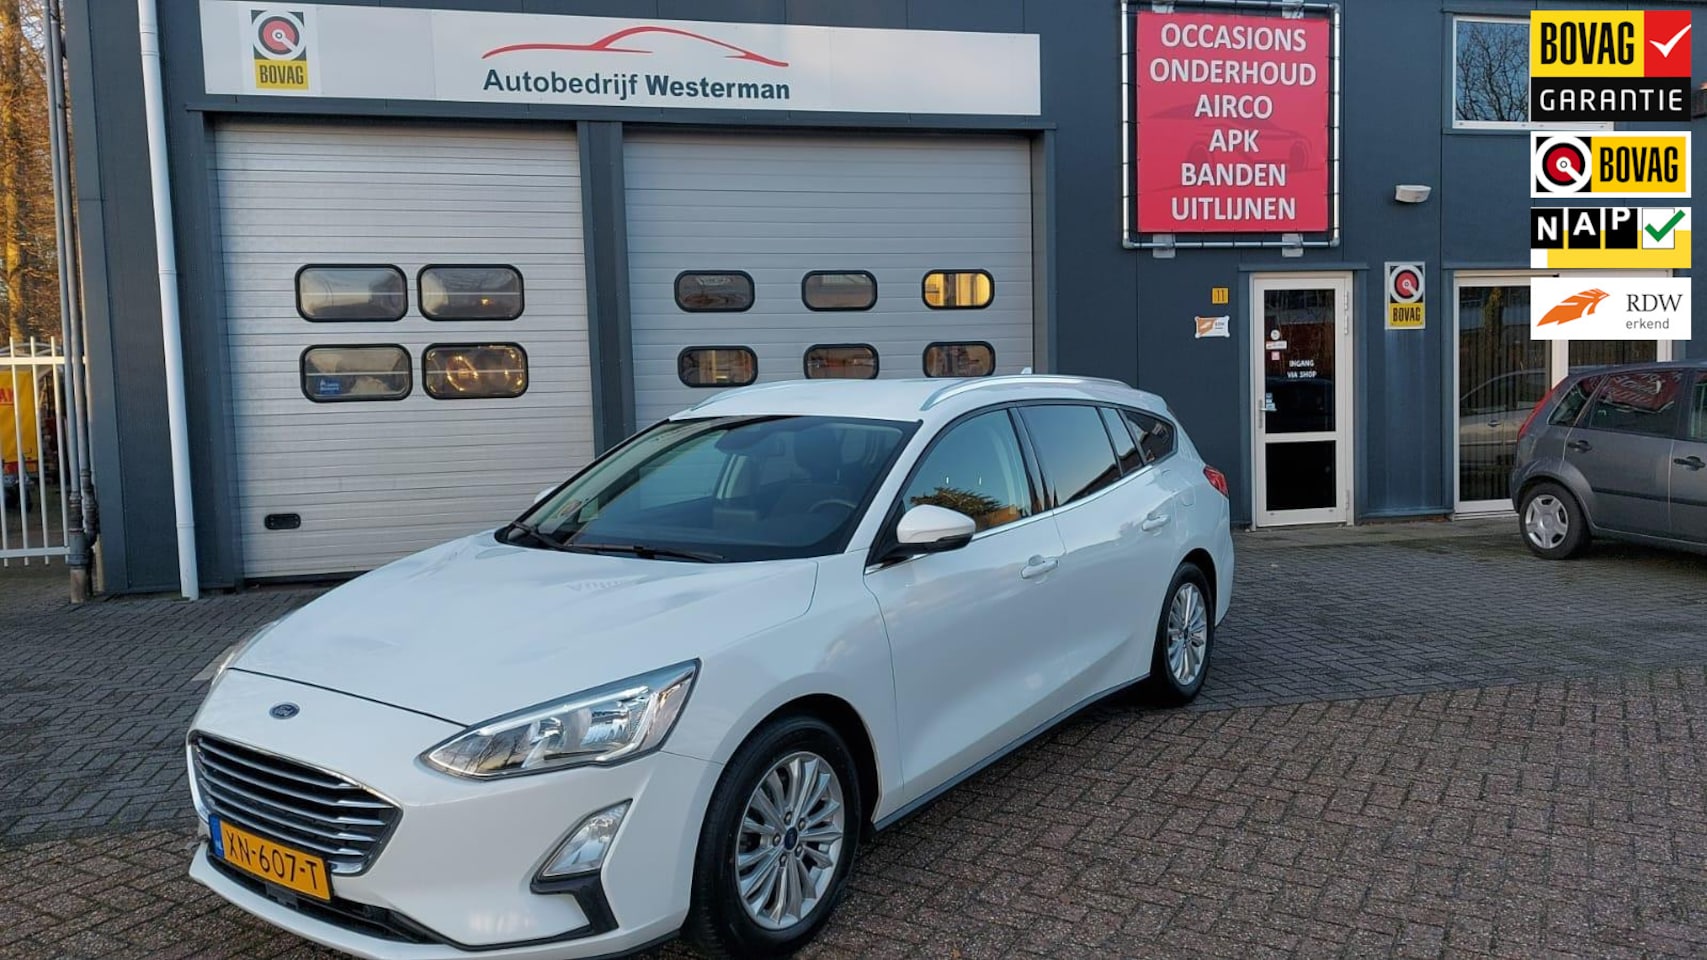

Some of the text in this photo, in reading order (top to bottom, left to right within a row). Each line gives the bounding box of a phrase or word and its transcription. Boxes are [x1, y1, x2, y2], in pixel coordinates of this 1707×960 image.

[1160, 23, 1307, 52] OCCASIONS
[259, 64, 304, 85] BOVAG
[483, 69, 791, 100] Autobedrijf Westerman
[1149, 58, 1316, 86] ONDERHOUD
[1194, 94, 1273, 119] AIRCO
[1208, 128, 1260, 153] APK
[1181, 163, 1287, 187] BANDEN
[1171, 197, 1296, 221] UITLIJNEN
[1216, 289, 1225, 302] 11
[1392, 307, 1421, 322] BOVAG
[226, 829, 317, 890] XN-607-T
